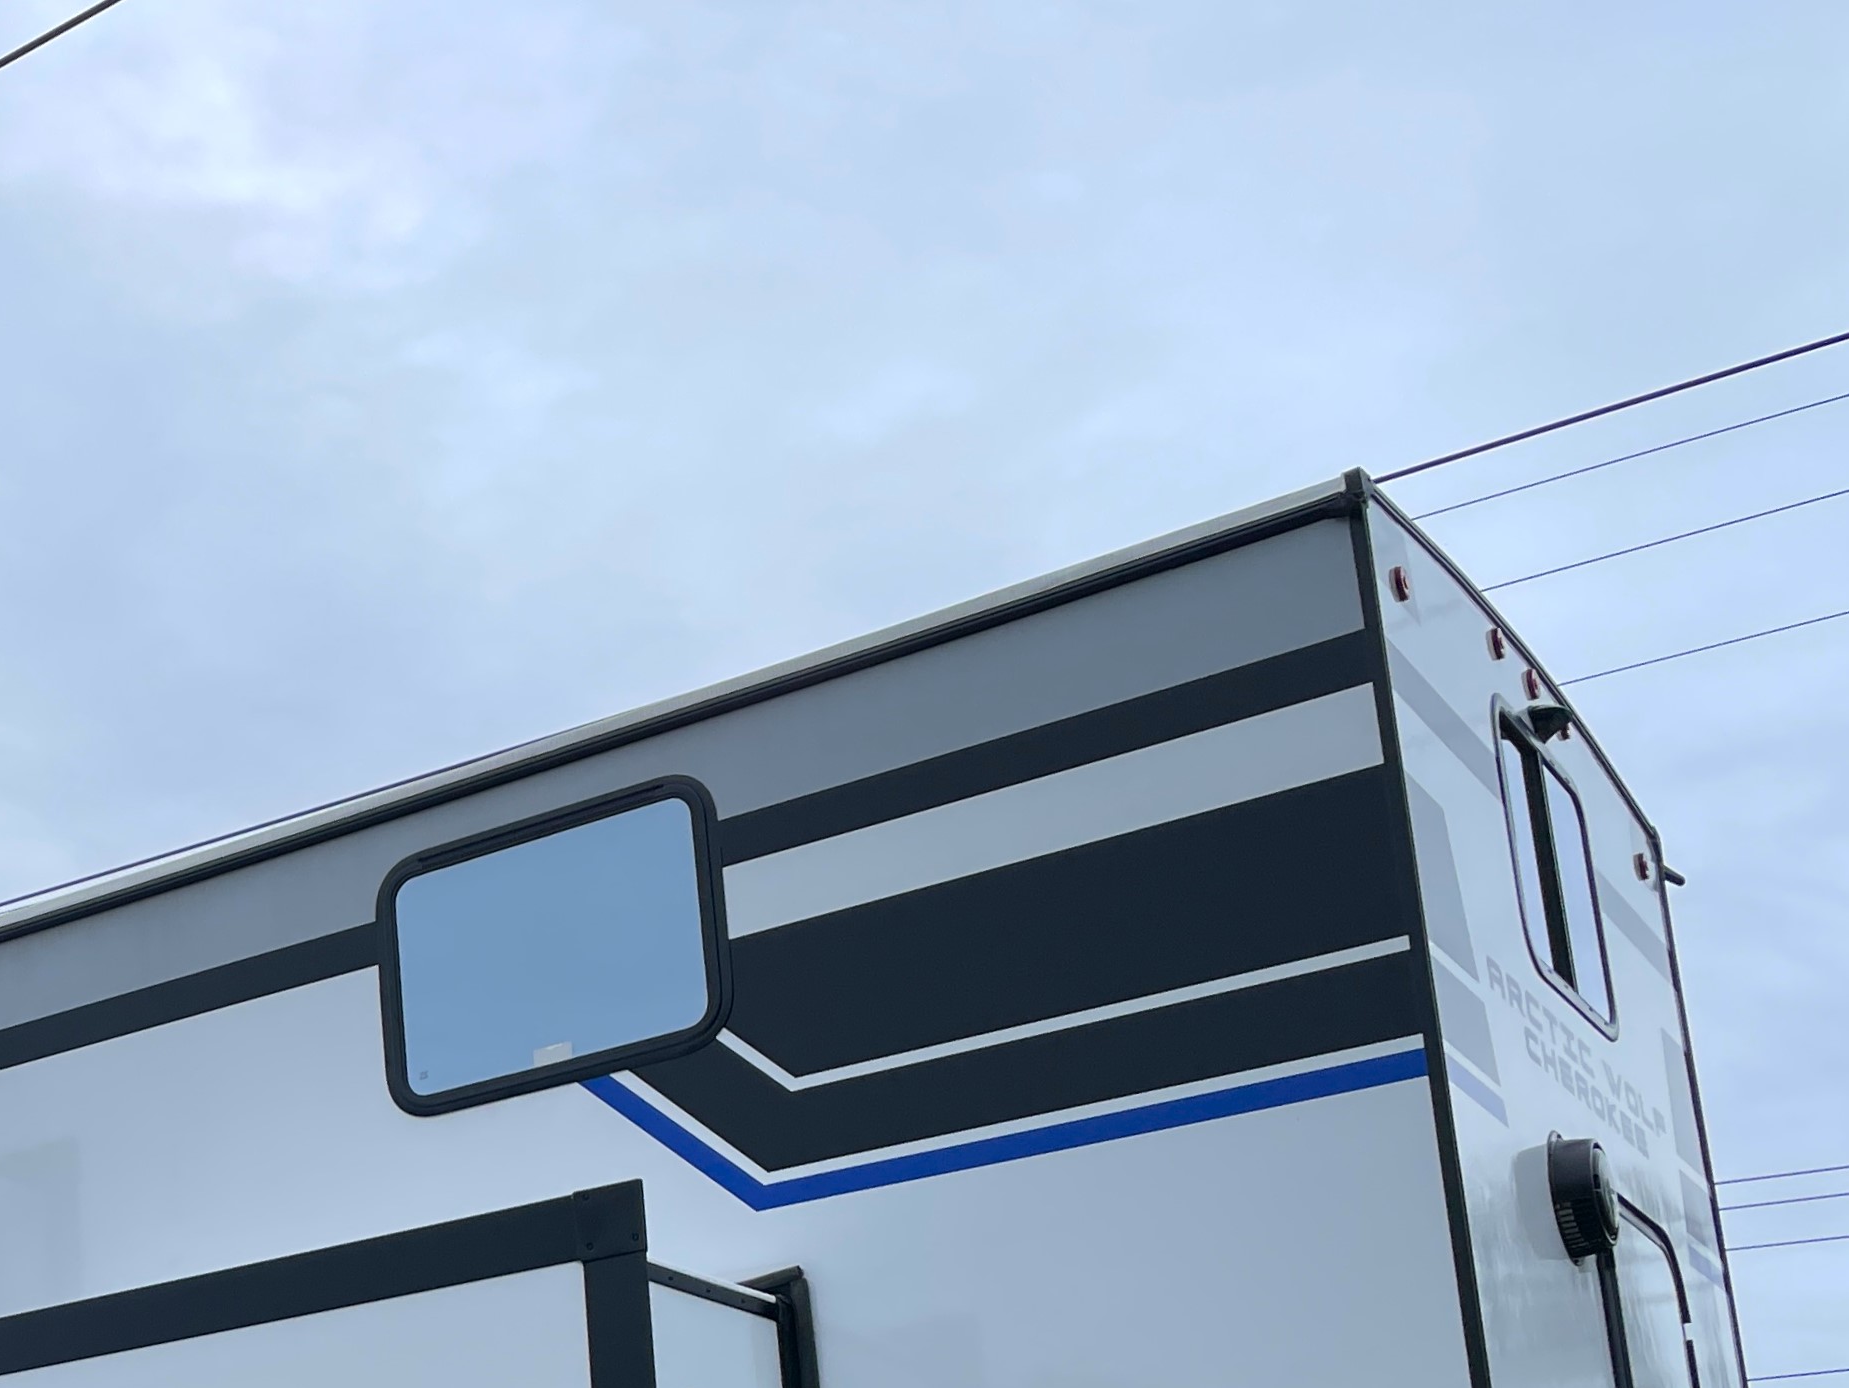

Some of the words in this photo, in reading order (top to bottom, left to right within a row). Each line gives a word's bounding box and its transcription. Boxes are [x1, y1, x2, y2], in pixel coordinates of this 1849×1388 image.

[1486, 955, 1595, 1080] ARCTIC
[1602, 1059, 1667, 1138] WOLF
[1524, 1026, 1649, 1160] CHEROKEE
